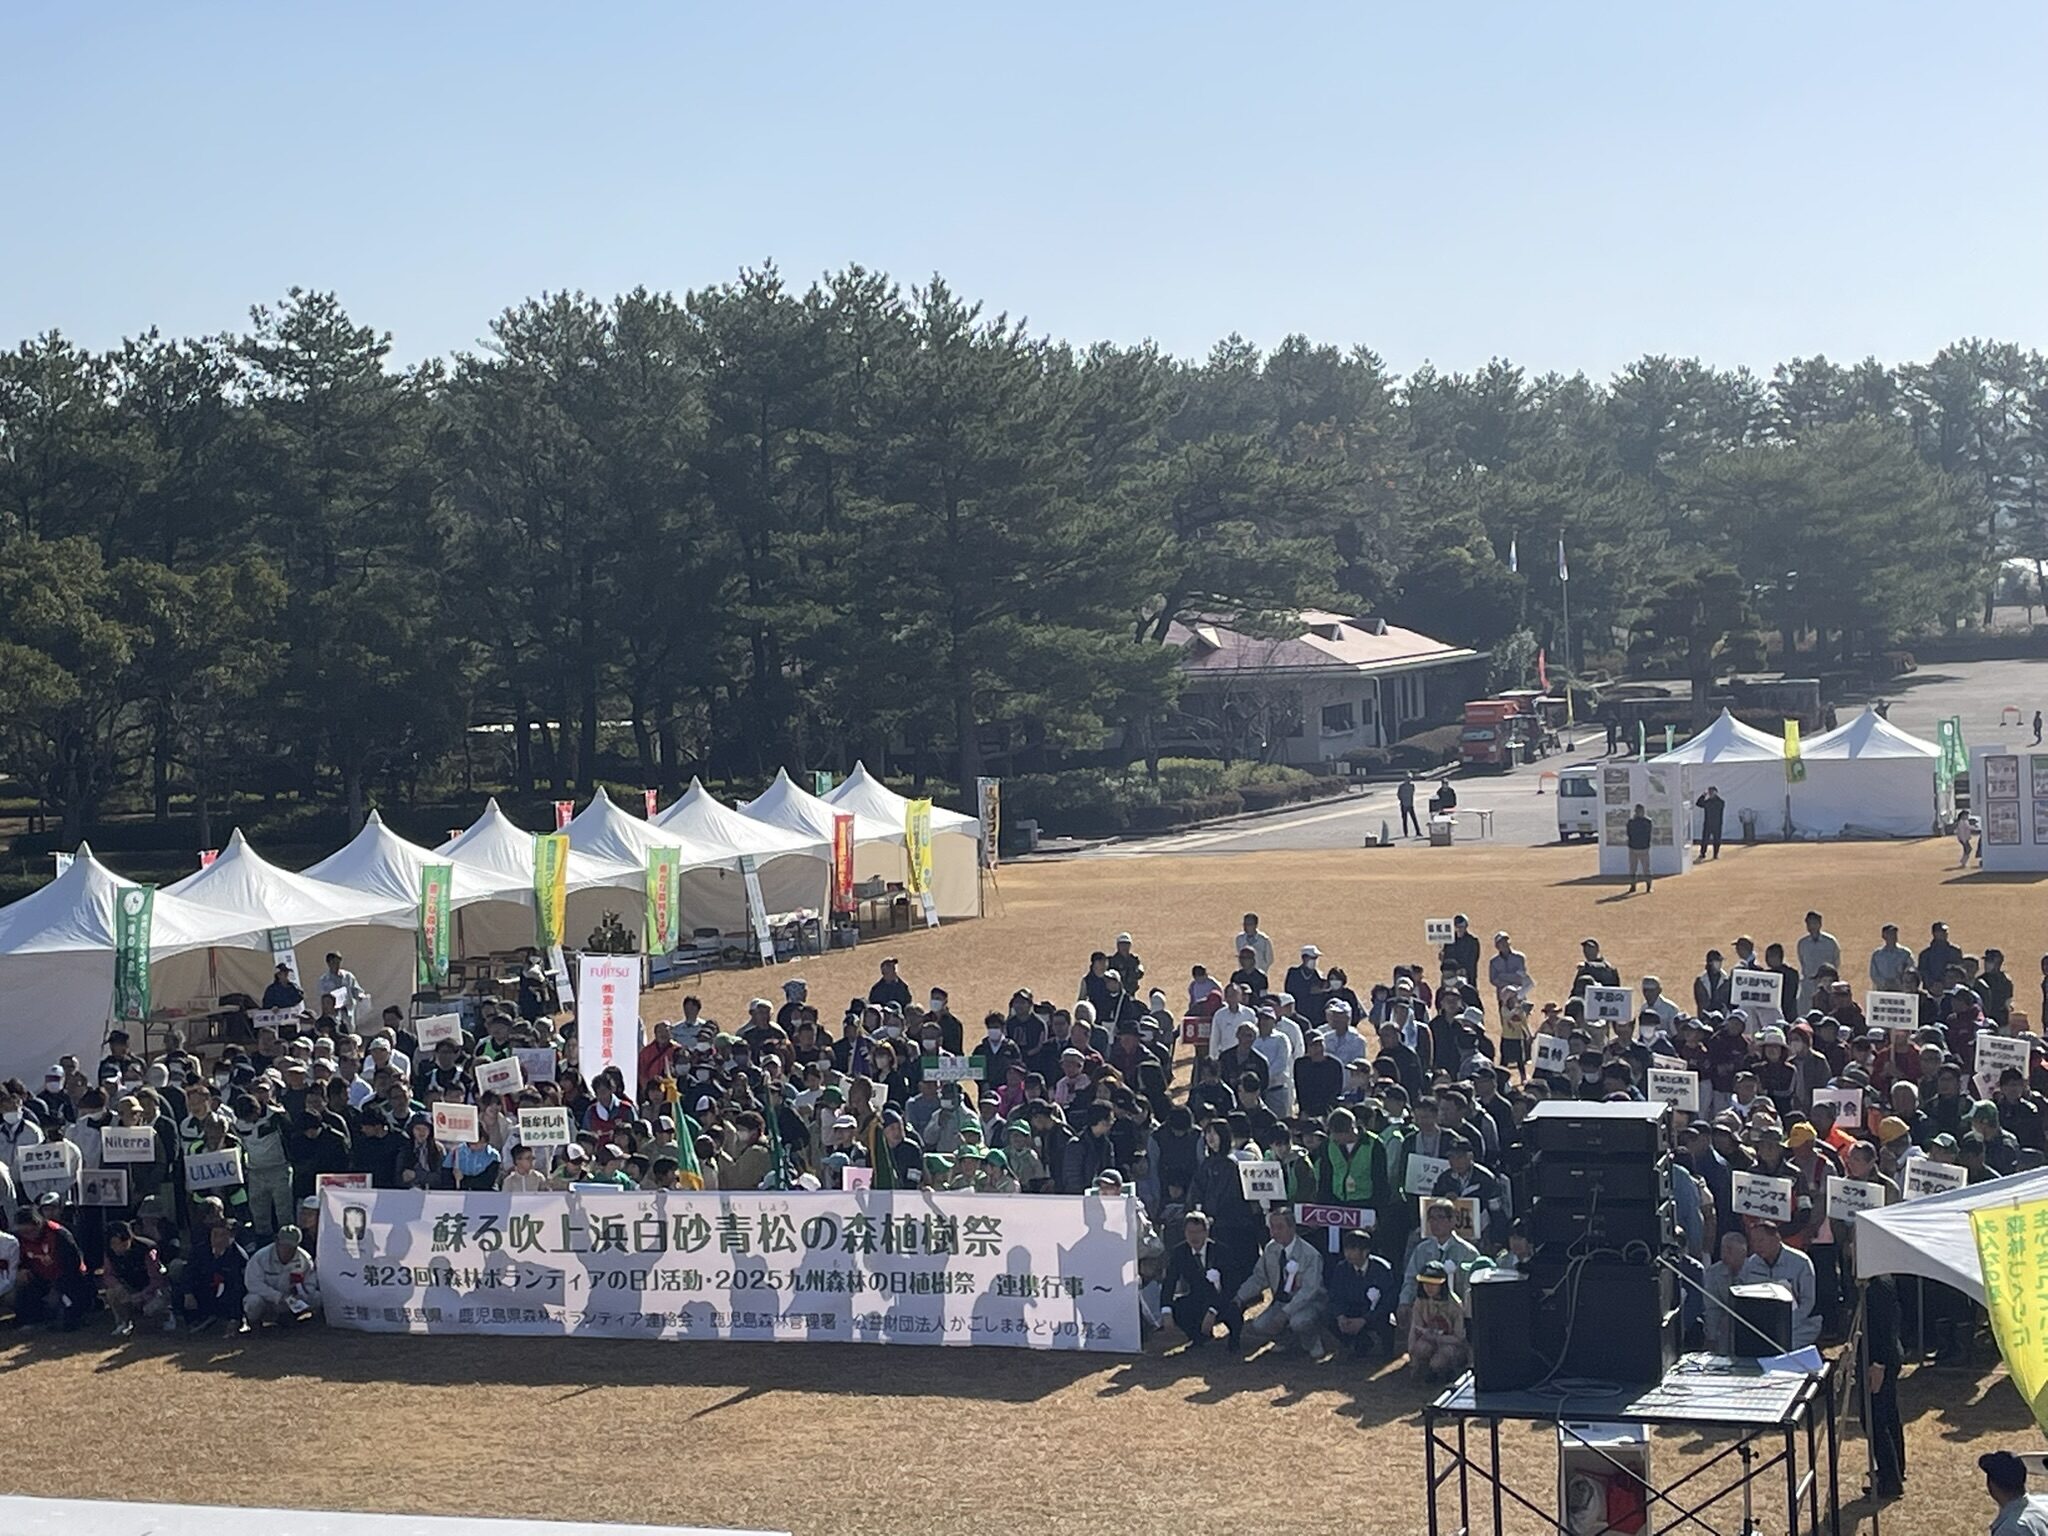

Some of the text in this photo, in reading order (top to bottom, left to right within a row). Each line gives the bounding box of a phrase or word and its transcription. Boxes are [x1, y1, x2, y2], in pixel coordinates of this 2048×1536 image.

[590, 960, 630, 979] FUJITSU
[190, 1160, 236, 1181] ULVAC
[431, 1212, 1003, 1257] 蘇る吹上浜白砂青松の森植樹祭
